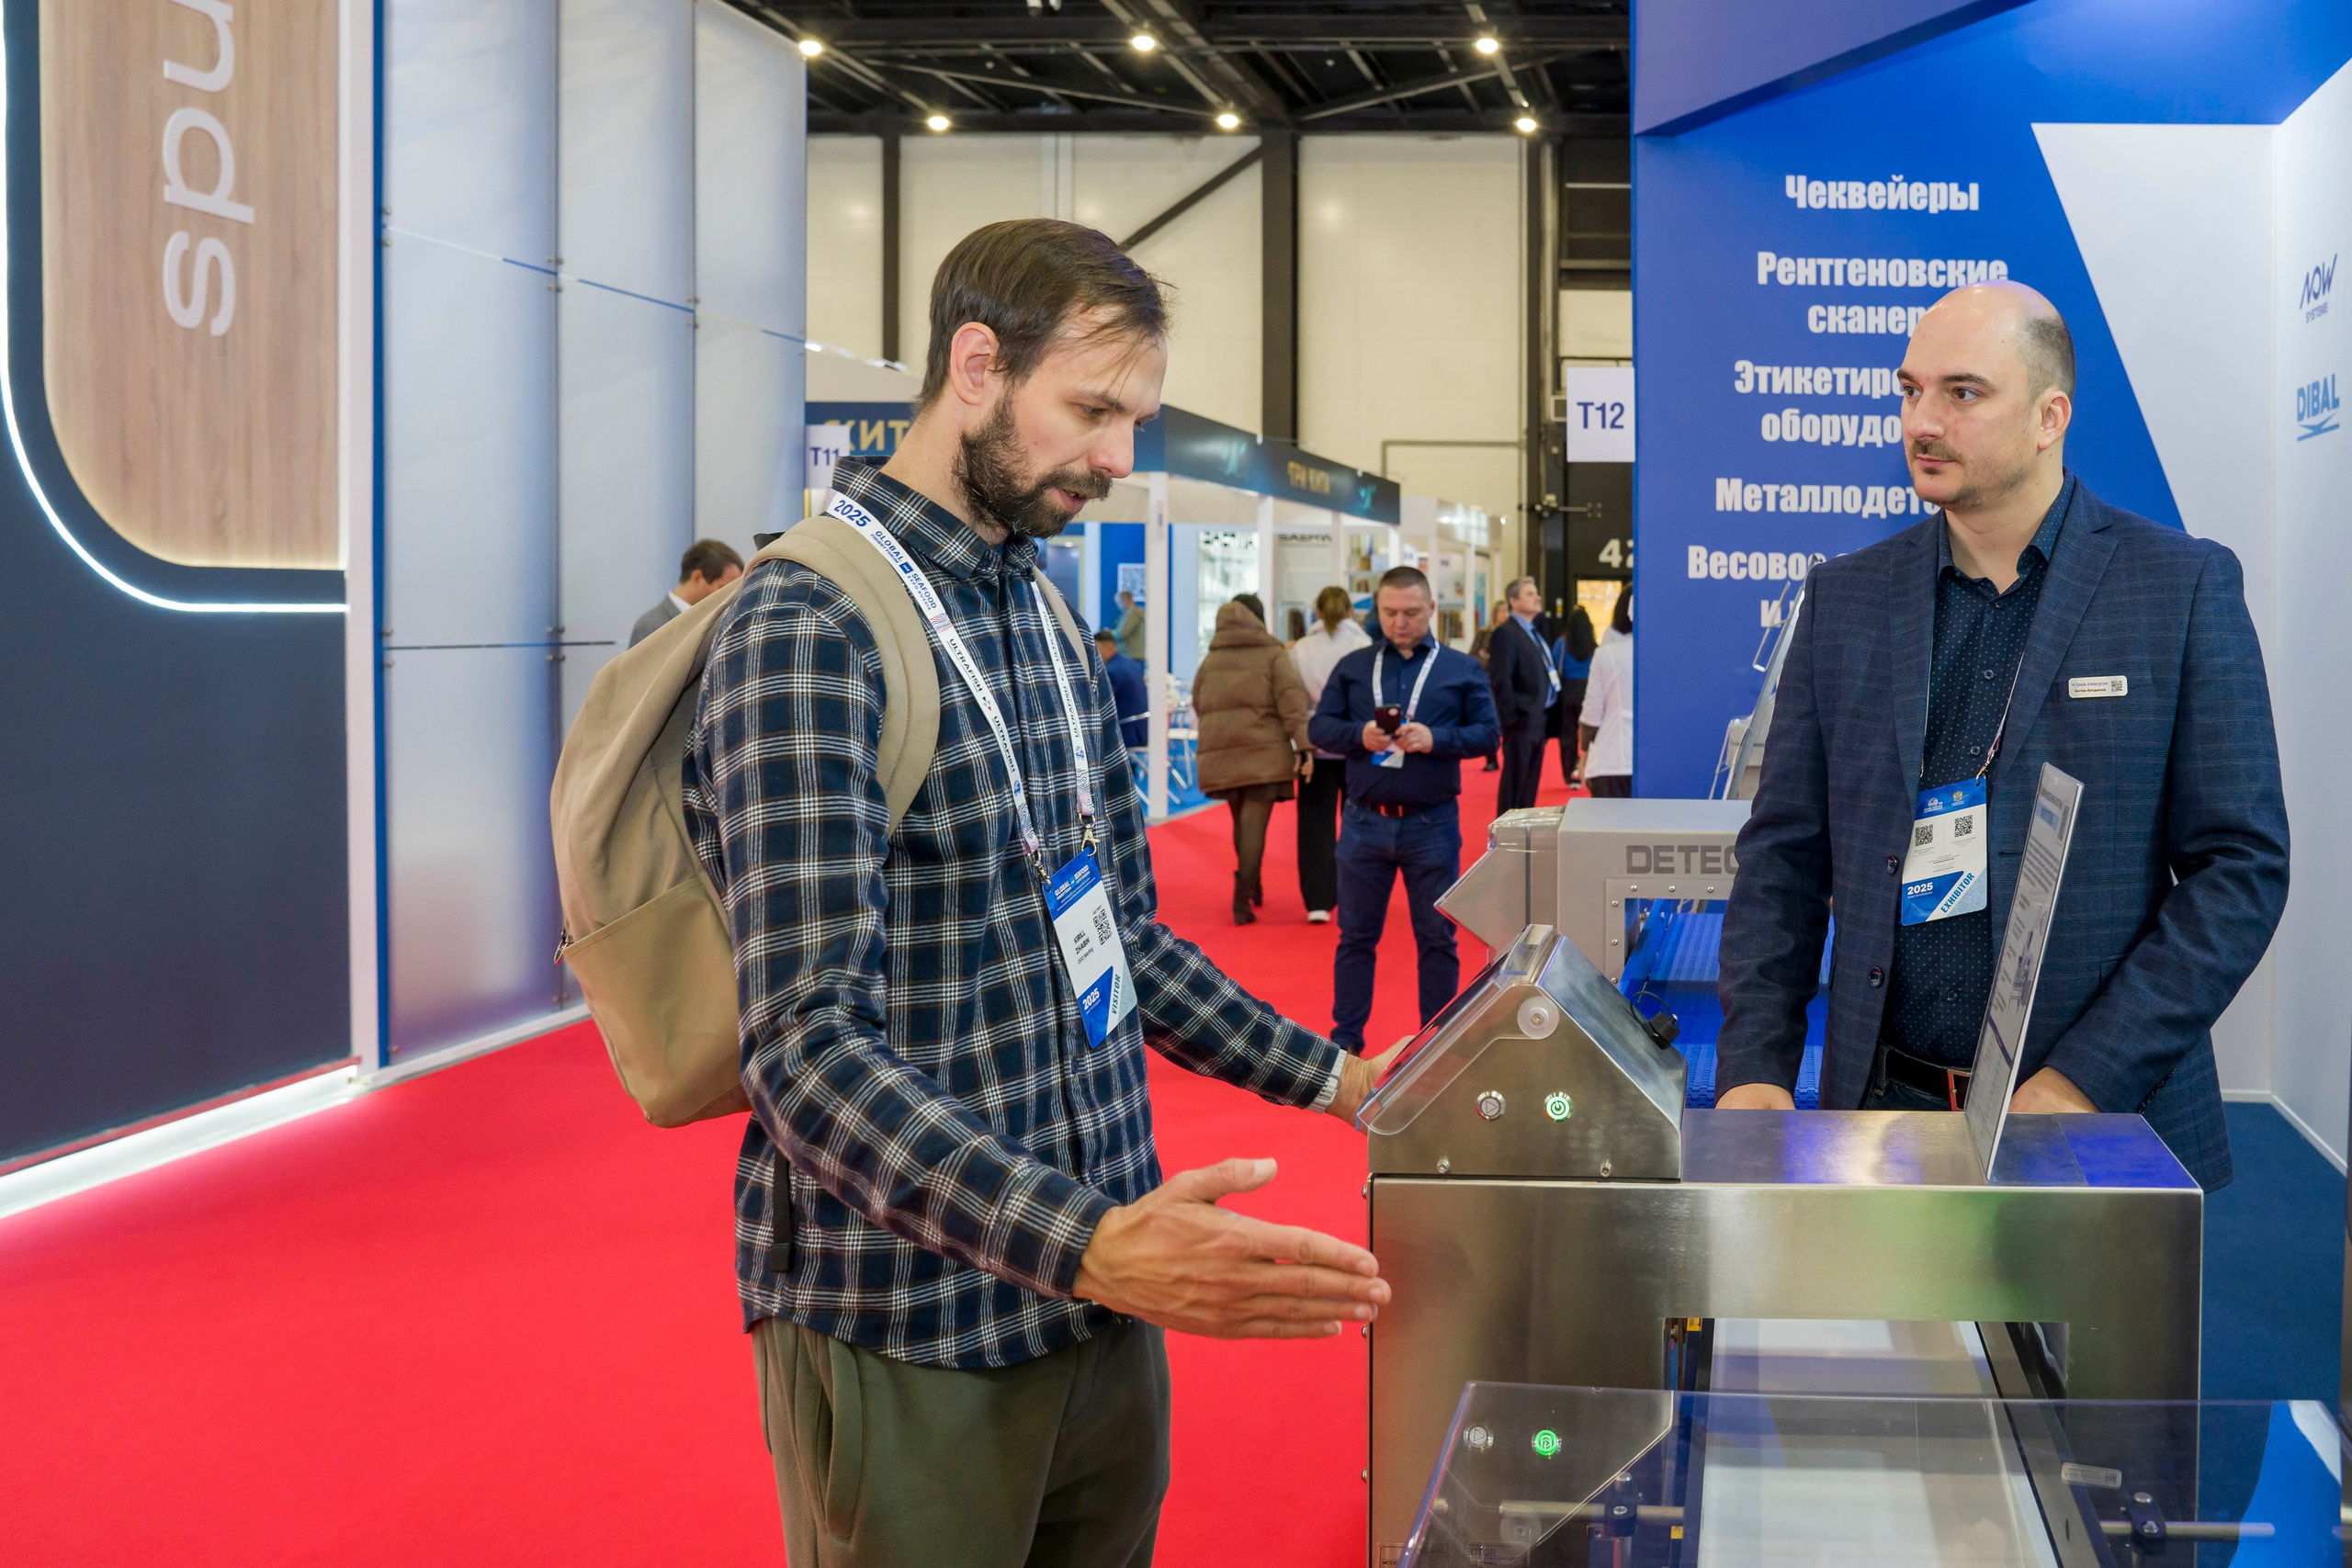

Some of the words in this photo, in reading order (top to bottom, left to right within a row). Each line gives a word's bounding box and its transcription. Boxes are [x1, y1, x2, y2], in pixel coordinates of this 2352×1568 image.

[1785, 175, 1979, 214] Чеквейеры
[1758, 252, 2008, 288] Рентгеновские
[1577, 401, 1625, 429] T12
[2297, 373, 2340, 423] DIBAL
[1761, 408, 1903, 447] оборудо
[834, 500, 872, 527] 2025
[875, 530, 904, 561] GLOBAL
[907, 575, 919, 590] EXPO
[918, 591, 932, 611] RUSSIA
[912, 573, 937, 609] SEAFOOD
[1043, 611, 1059, 662] ULTRAFISH
[949, 638, 983, 692] ULTRAFISH
[1063, 685, 1080, 738] ULTRAFISH
[993, 716, 1016, 773] ULTRAFISH
[1626, 845, 1739, 874] DETEC
[1907, 882, 1933, 896] 2025
[1940, 873, 1974, 913] EXHIBITOR
[1082, 987, 1100, 1010] 2025
[1112, 974, 1121, 1014] VISITOR
